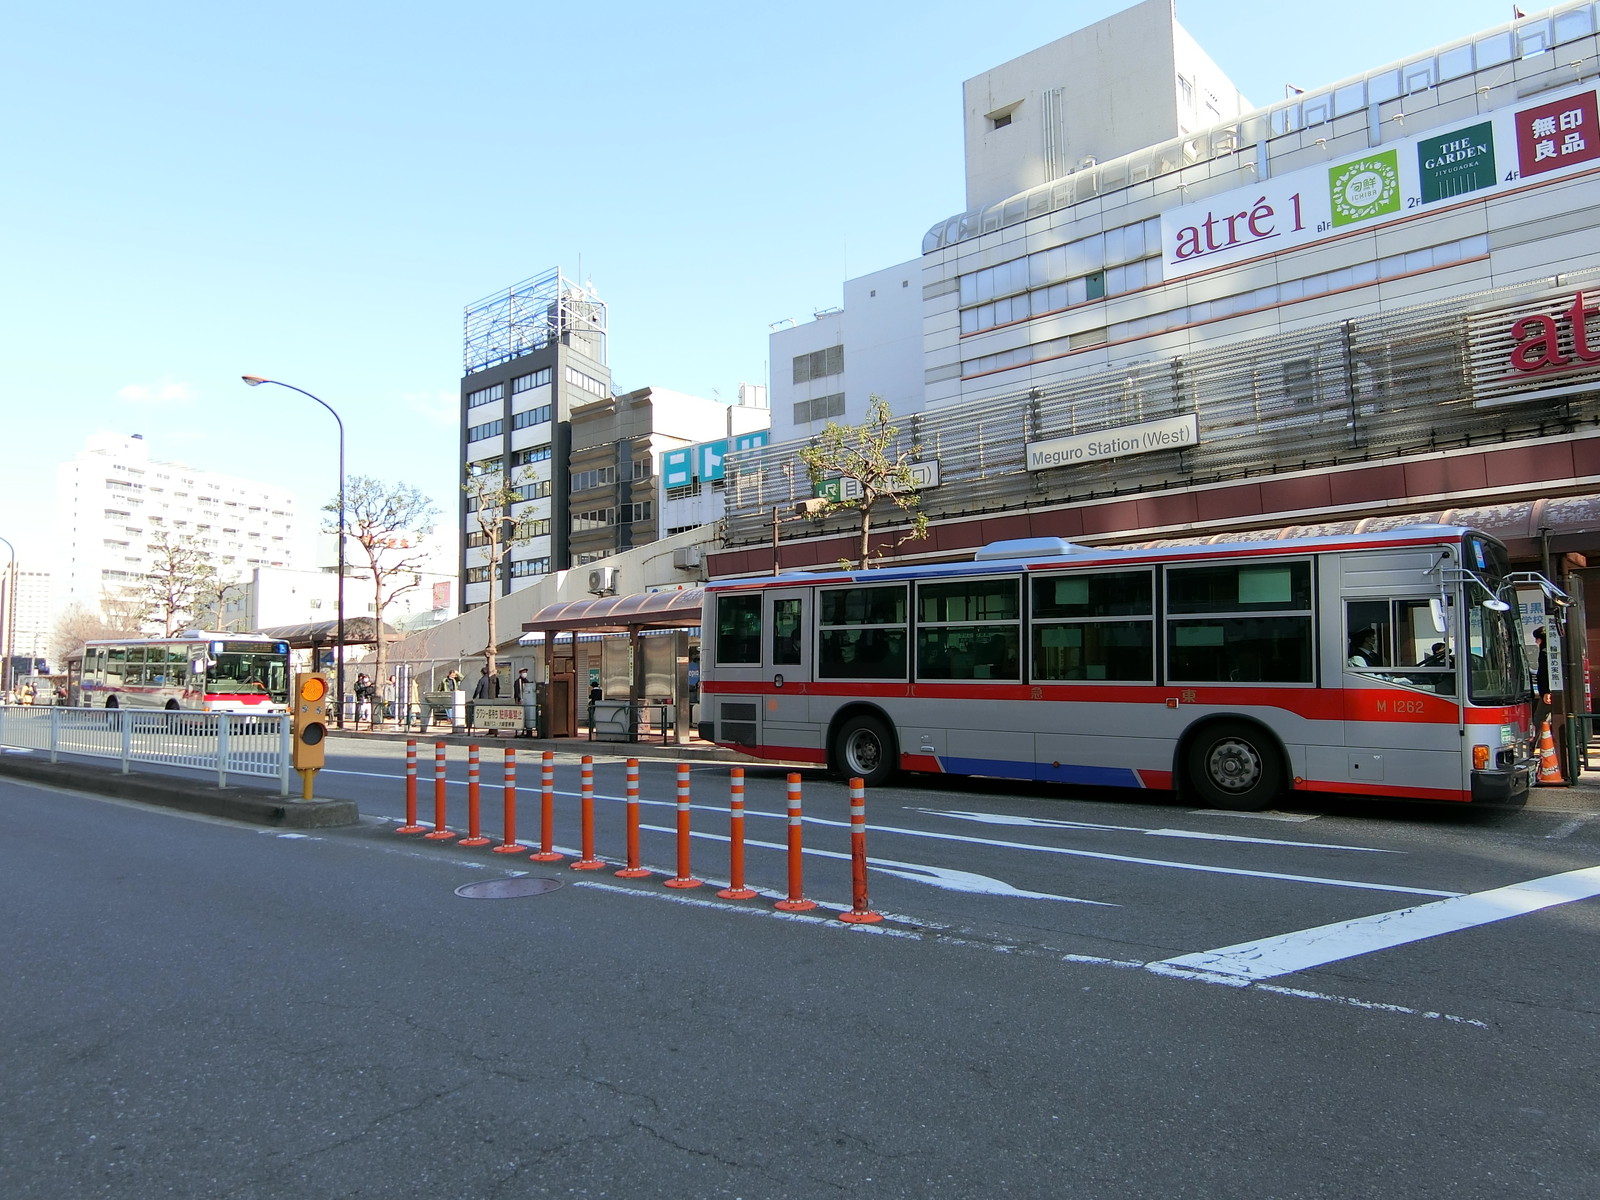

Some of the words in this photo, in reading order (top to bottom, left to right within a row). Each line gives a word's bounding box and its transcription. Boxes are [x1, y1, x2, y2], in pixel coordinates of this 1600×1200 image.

[1531, 108, 1582, 139] 無印
[1440, 137, 1470, 154] THE
[1534, 132, 1585, 162] 良品
[1425, 144, 1487, 169] GARDEN
[1435, 161, 1479, 177] JIYUGAOKA
[1504, 170, 1519, 181] 4F
[1351, 190, 1378, 201] ICHIBA
[1407, 197, 1421, 208] 2F
[1175, 196, 1276, 259] atré
[1288, 192, 1307, 233] 1
[1317, 221, 1331, 233] B1F
[1032, 448, 1084, 466] Meguro
[1087, 438, 1140, 456] Station
[1142, 425, 1190, 449] (West)
[668, 436, 762, 484] ニトリ
[819, 483, 836, 497] JR
[1519, 602, 1543, 614] 目黒
[1521, 615, 1544, 625] 学校
[1030, 687, 1043, 699] 急
[1181, 689, 1197, 703] 東
[1376, 700, 1387, 713] M
[1393, 701, 1424, 714] 1262
